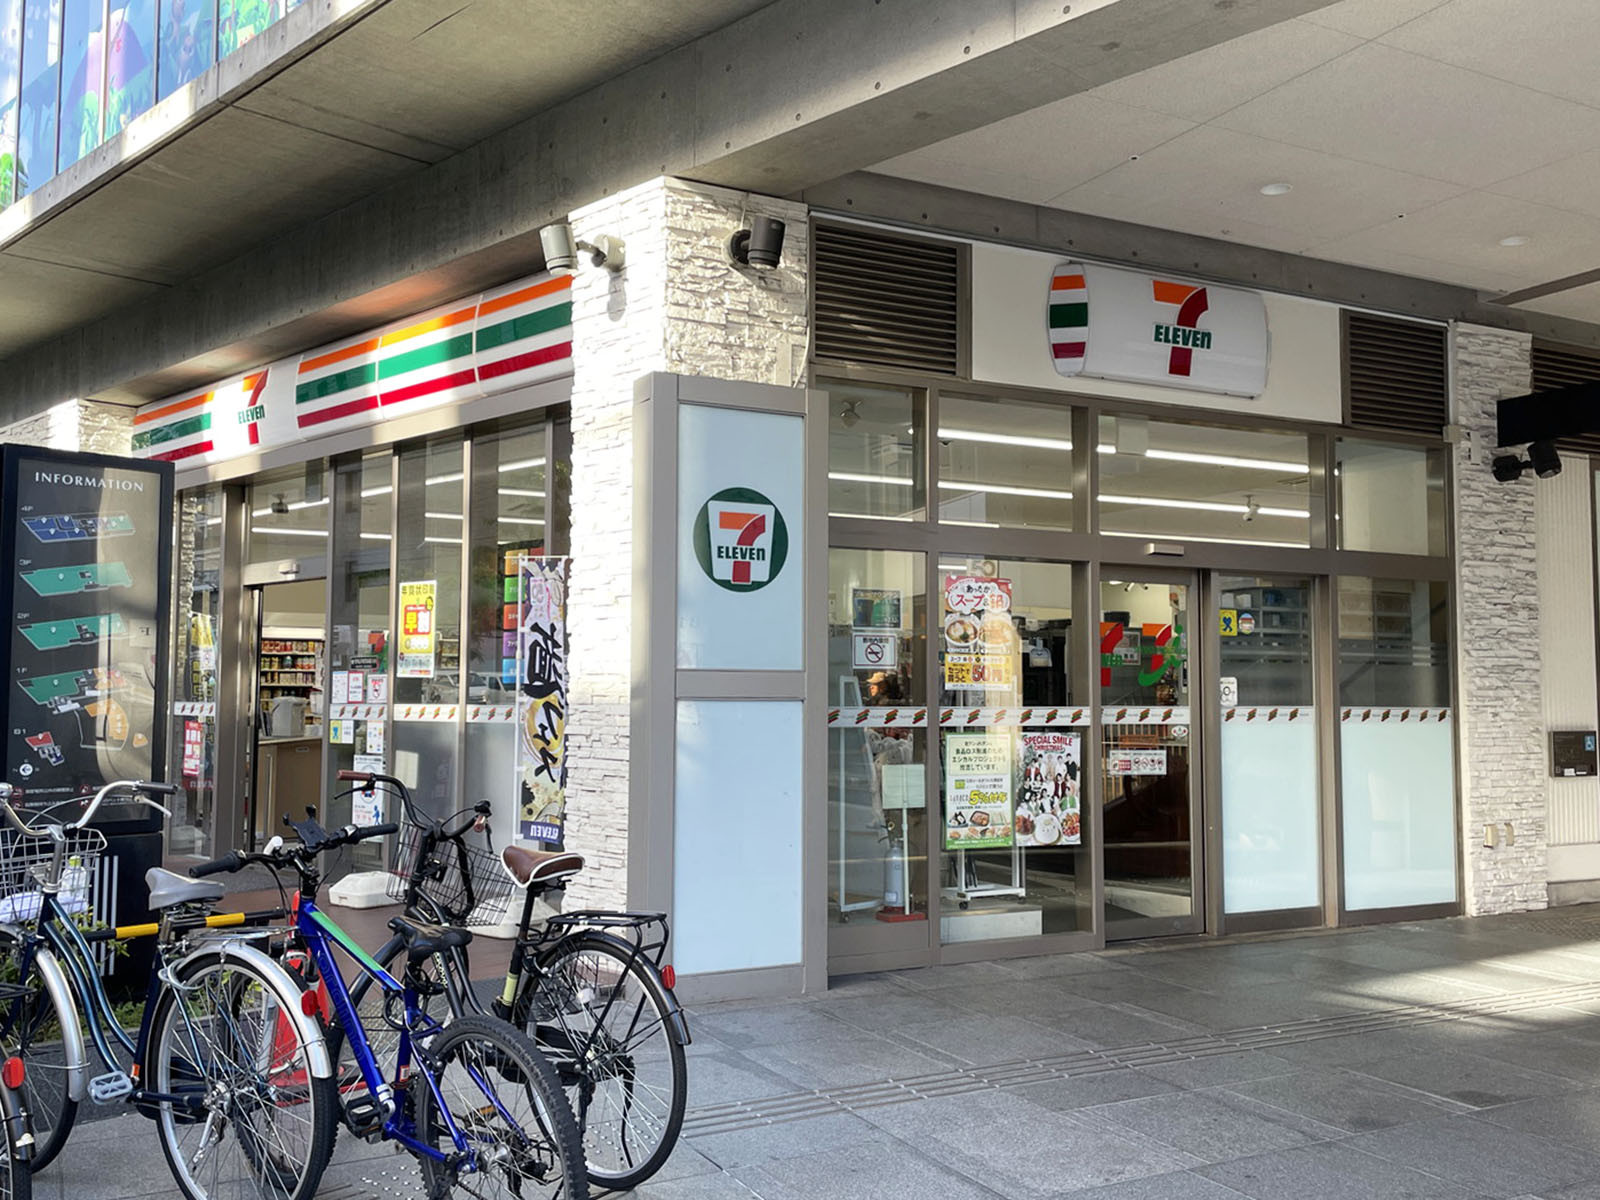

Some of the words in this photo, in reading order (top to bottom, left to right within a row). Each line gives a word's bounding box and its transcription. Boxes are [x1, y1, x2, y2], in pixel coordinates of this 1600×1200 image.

[1152, 279, 1209, 377] 7
[241, 366, 269, 445] 7
[34, 471, 145, 493] INFORMATION
[718, 510, 767, 584] 7
[1023, 735, 1051, 747] SPECIAL
[1052, 735, 1073, 747] SMILE
